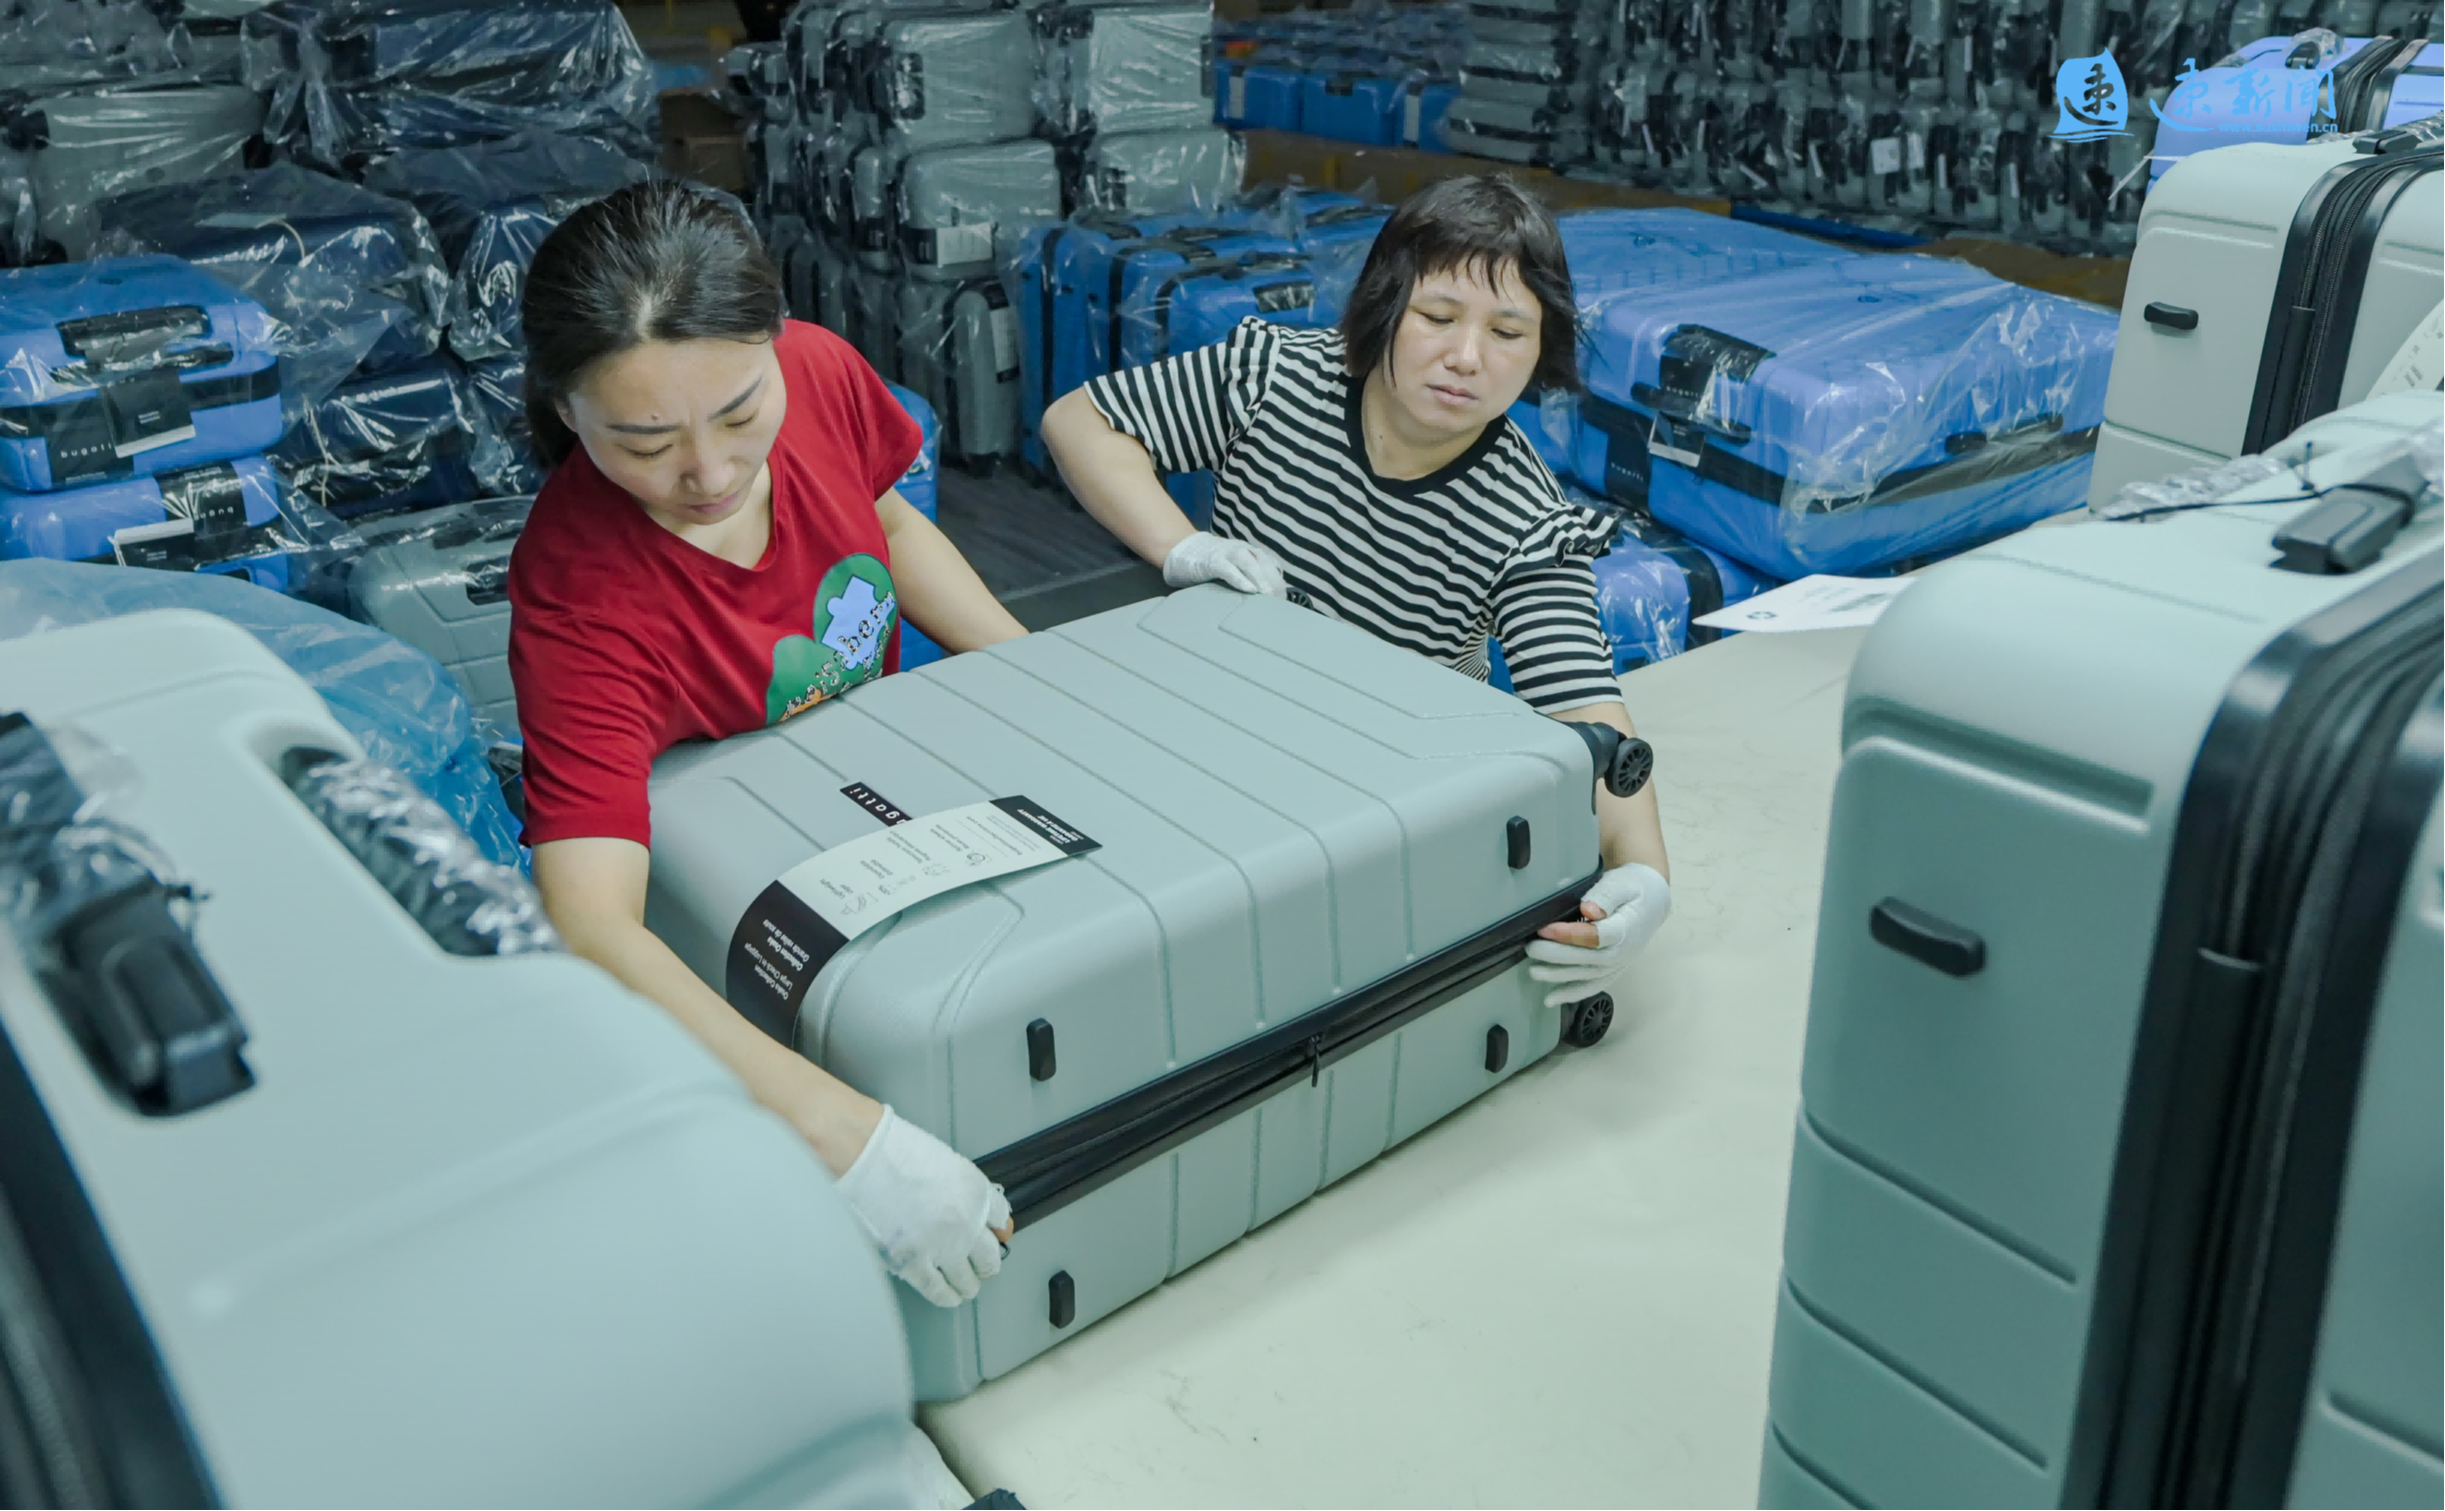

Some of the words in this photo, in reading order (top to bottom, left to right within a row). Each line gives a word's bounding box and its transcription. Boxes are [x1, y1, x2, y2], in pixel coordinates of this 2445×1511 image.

[1665, 385, 1700, 398] bugatt
[60, 442, 112, 459] bugatt
[762, 919, 776, 933] soute
[773, 929, 782, 938] de
[766, 936, 782, 953] Osaka
[780, 934, 794, 948] valise
[745, 942, 763, 962] Luggage
[780, 948, 804, 971] Collection
[792, 944, 810, 962] Grande
[754, 964, 776, 988] Collection
[780, 974, 793, 990] Large
[773, 983, 789, 1000] Osaka
